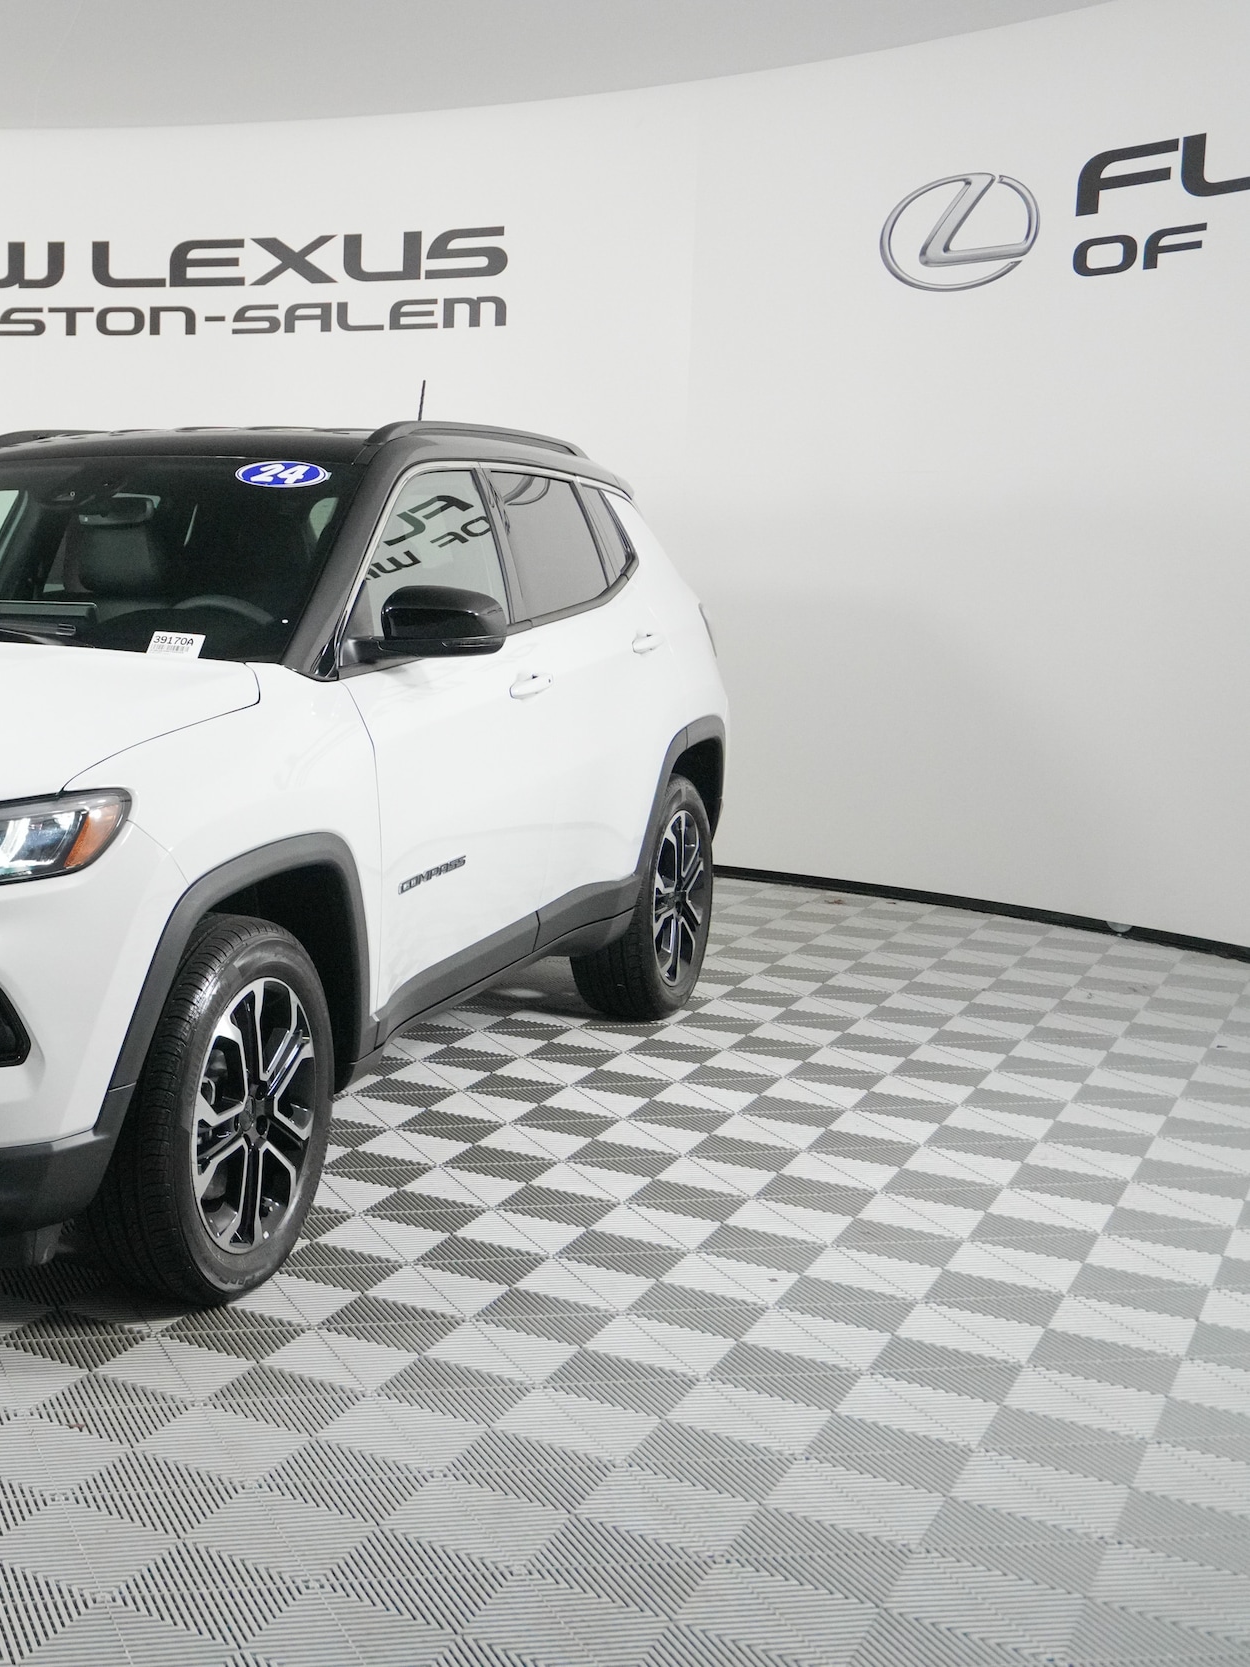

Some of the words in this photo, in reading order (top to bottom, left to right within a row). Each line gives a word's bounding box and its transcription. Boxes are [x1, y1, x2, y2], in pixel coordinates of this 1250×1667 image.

[92, 226, 508, 289] LEXUS
[1072, 222, 1208, 277] OF
[250, 463, 304, 484] 24
[153, 635, 194, 646] 39170A
[398, 855, 467, 895] COMPASS
